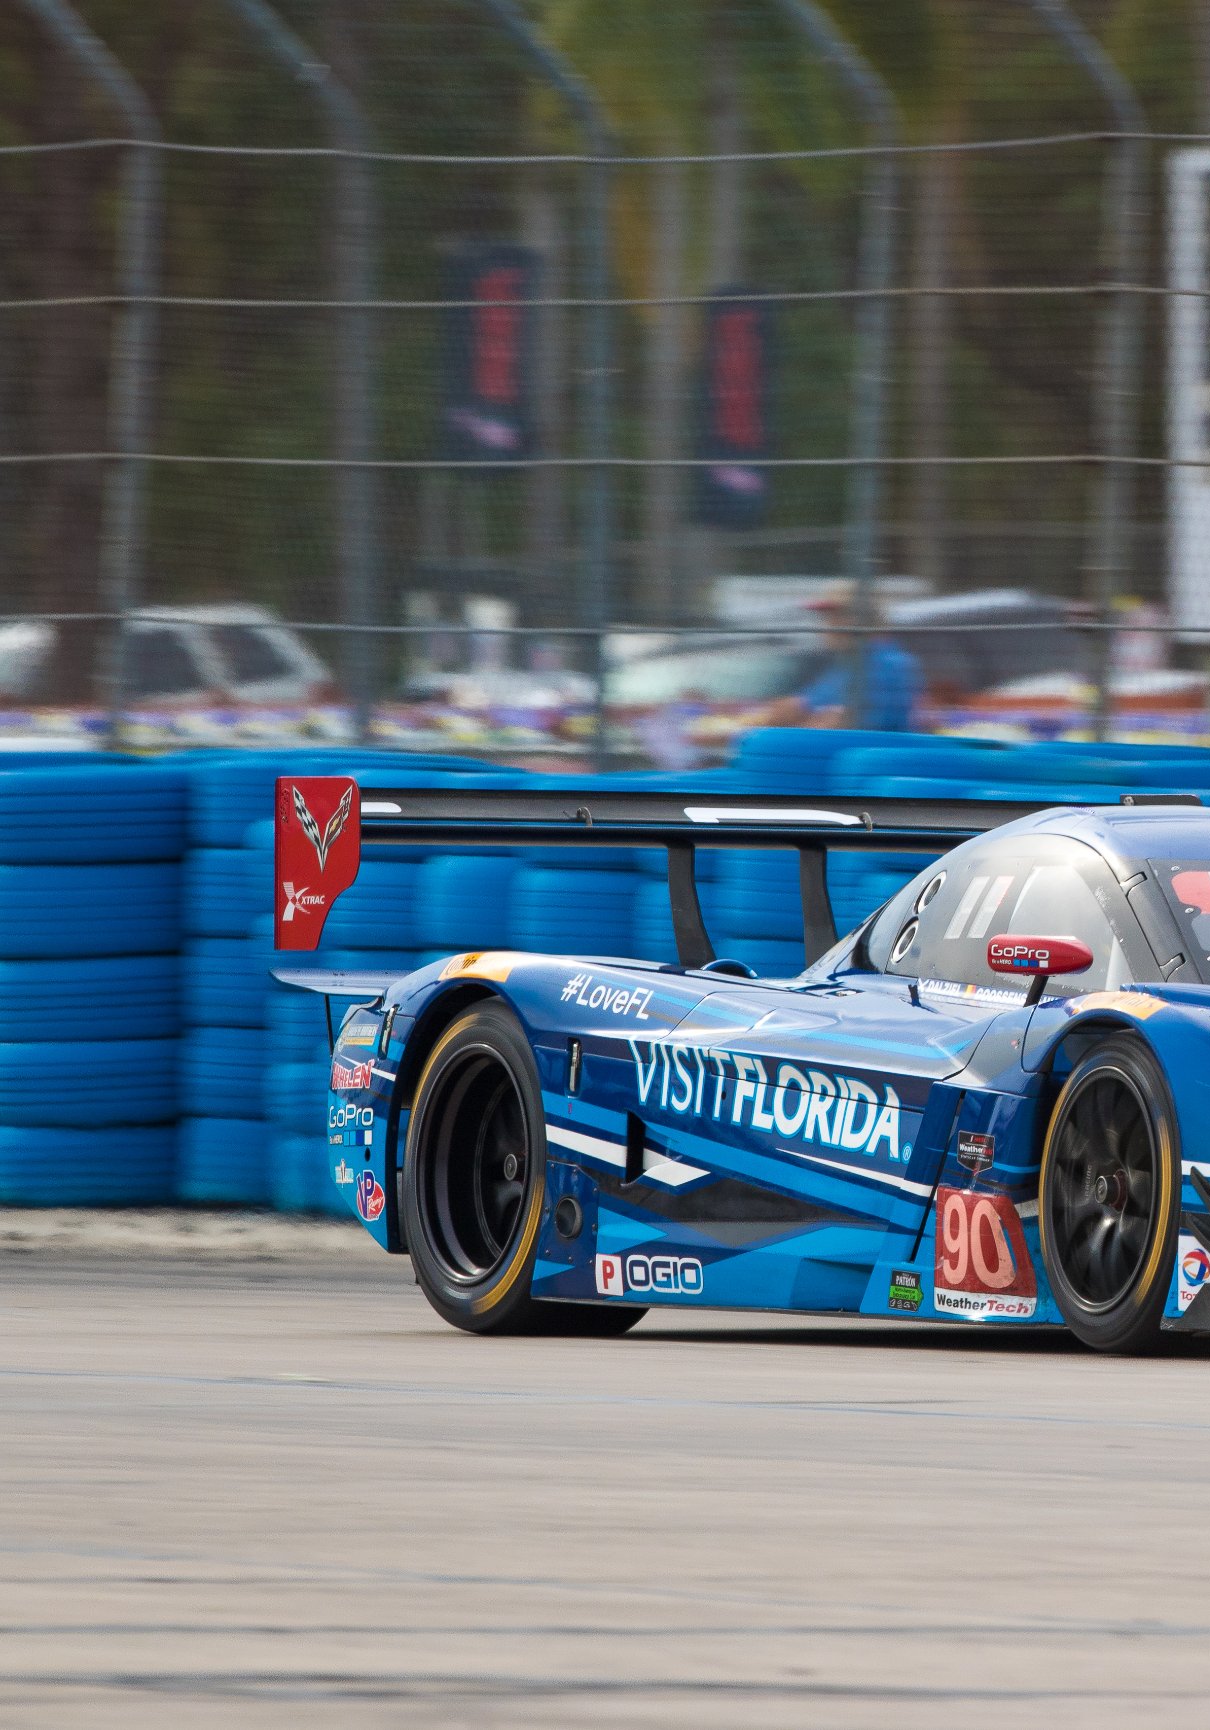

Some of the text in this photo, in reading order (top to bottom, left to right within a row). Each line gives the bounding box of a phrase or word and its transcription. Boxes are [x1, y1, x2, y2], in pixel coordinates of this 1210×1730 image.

[301, 895, 325, 905] XTRAC
[991, 944, 1050, 959] GoPro
[560, 973, 654, 1020] #LoveFL
[928, 980, 961, 994] DALZIEL
[329, 1103, 374, 1128] GoPro
[943, 1194, 1016, 1288] 90
[626, 1255, 703, 1294] OGIO
[936, 1293, 1029, 1314] WeatherTech
